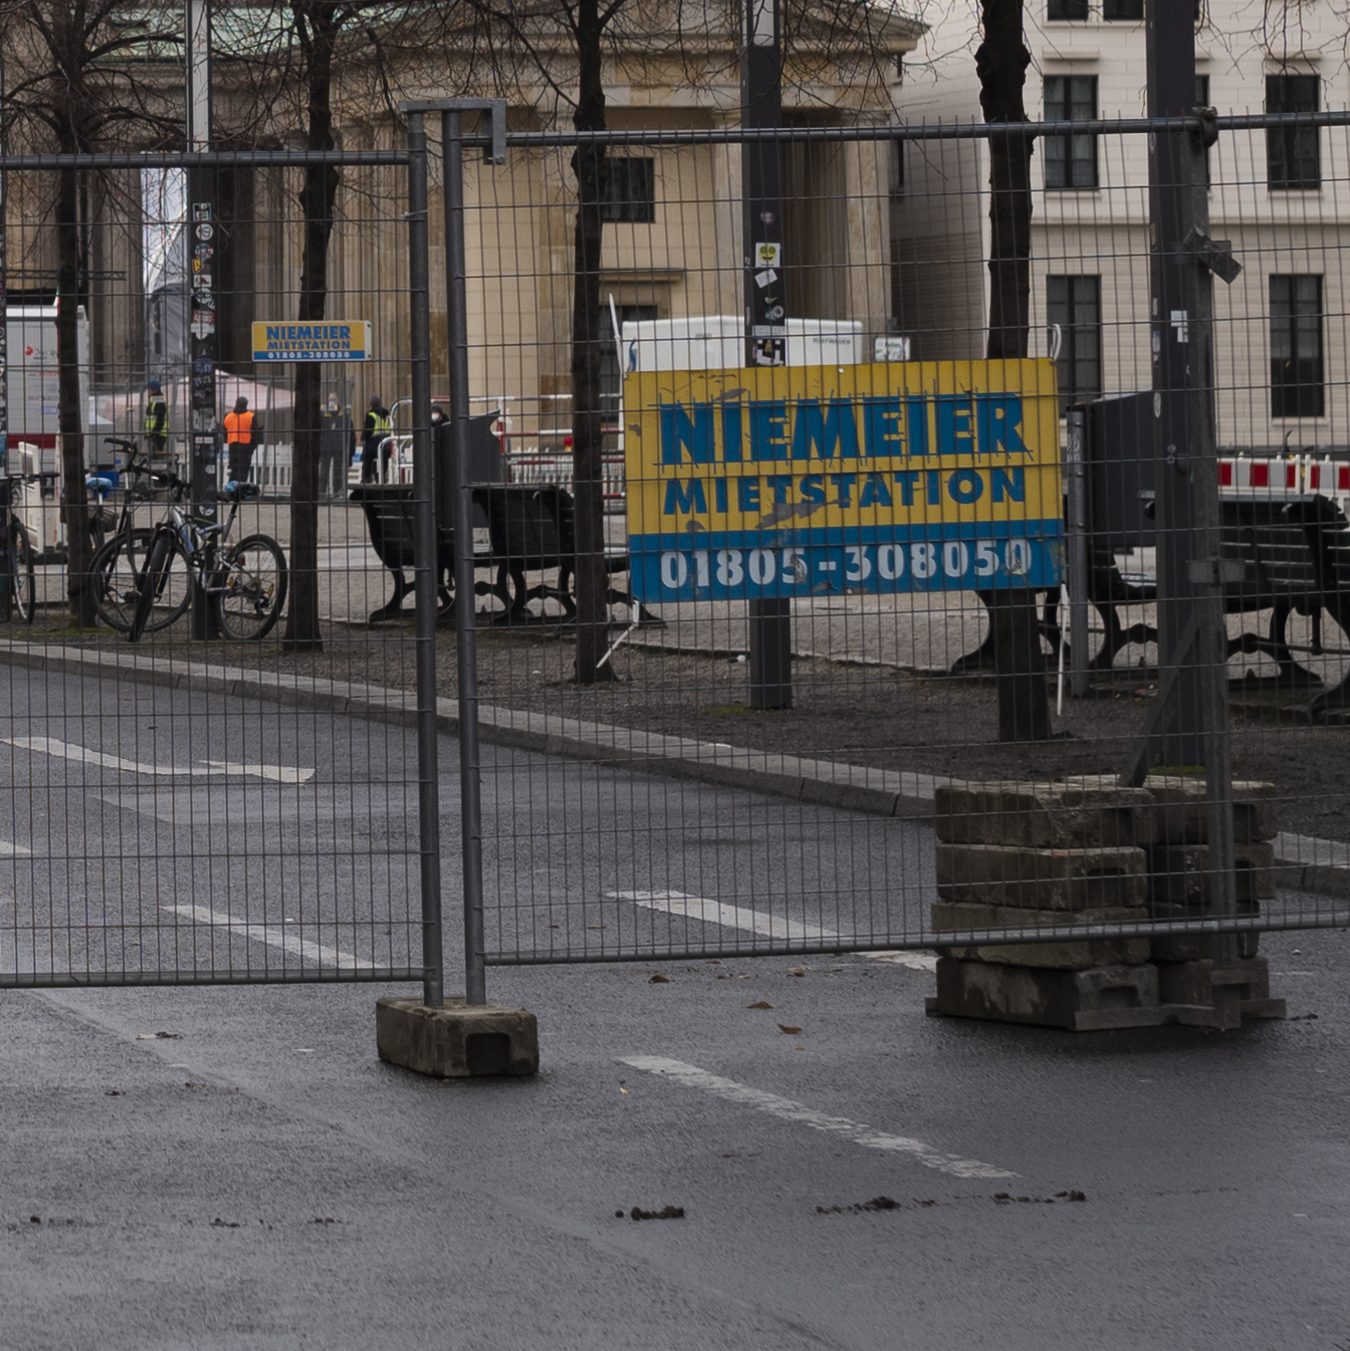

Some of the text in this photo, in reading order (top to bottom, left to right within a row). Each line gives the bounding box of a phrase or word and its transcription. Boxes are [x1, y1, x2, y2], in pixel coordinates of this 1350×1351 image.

[266, 325, 351, 340] NIEMEIER
[267, 340, 351, 350] MIETSTATION
[268, 351, 350, 359] 01805-308050
[657, 391, 1034, 467] NIEMEIER
[663, 467, 1026, 516] MIETSTATION
[659, 537, 1034, 589] 01805-308050
